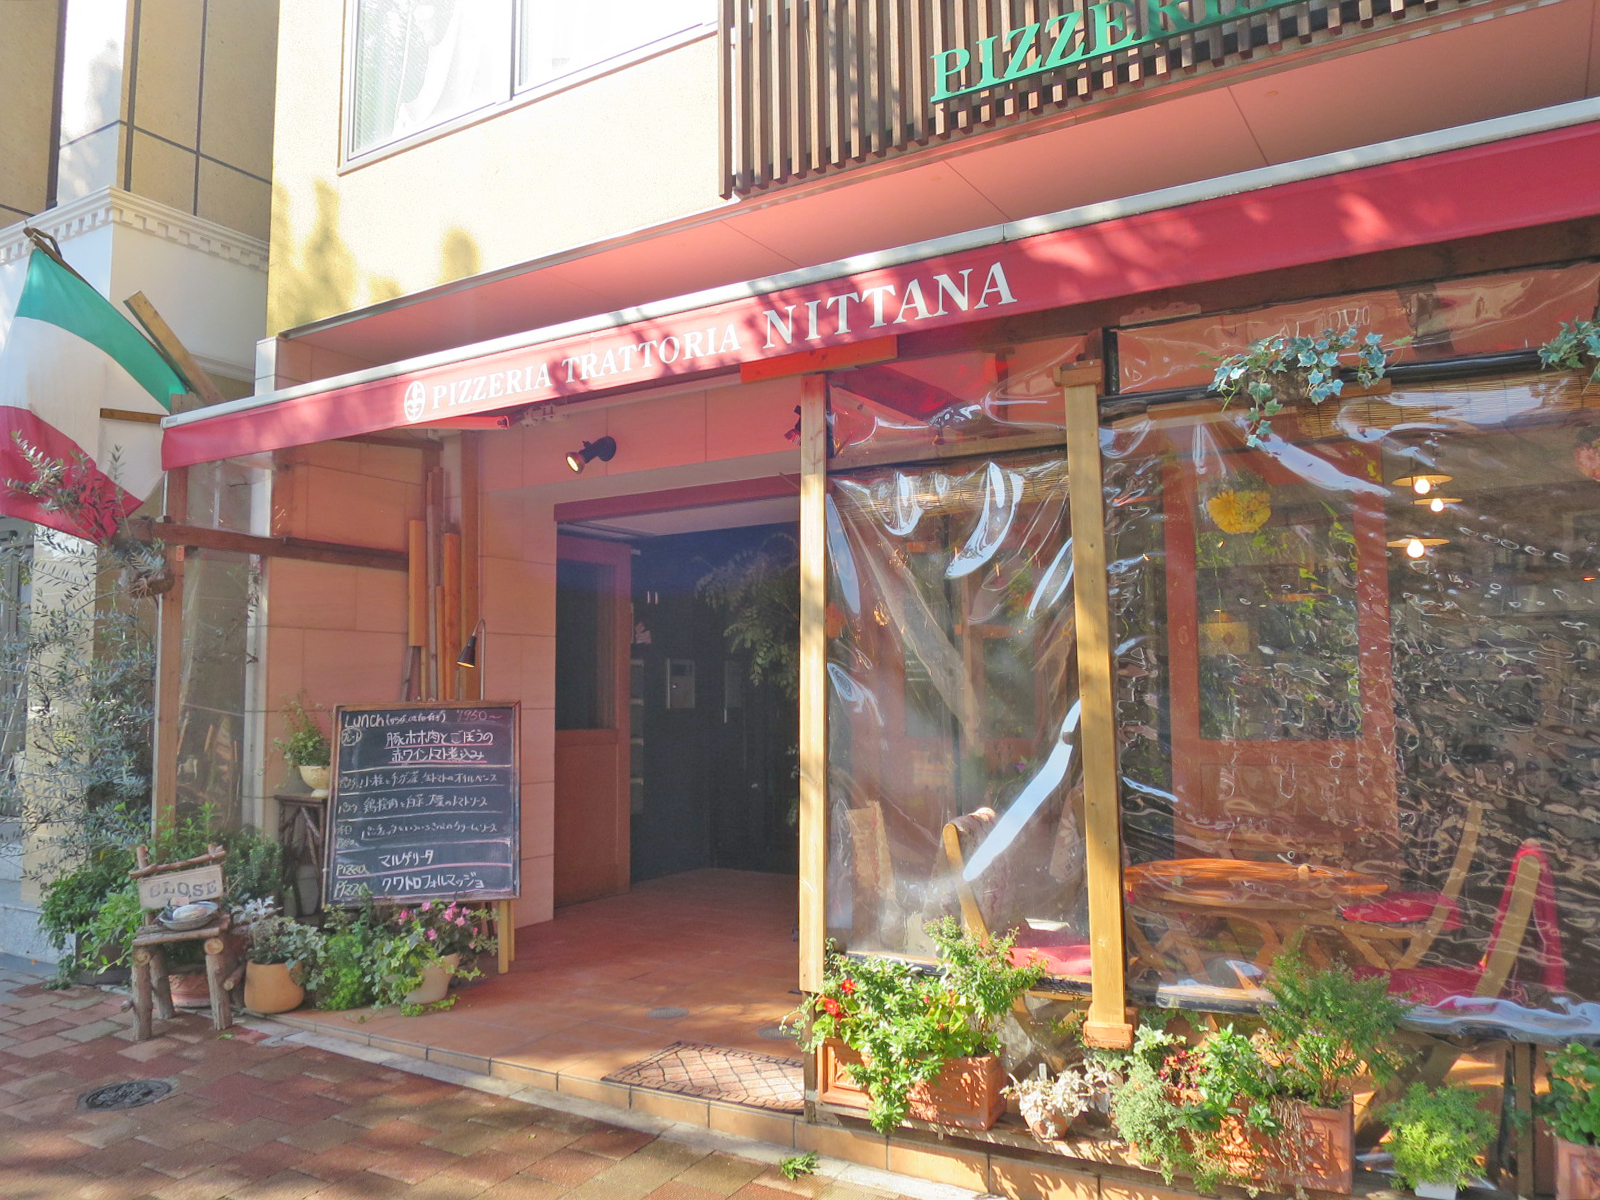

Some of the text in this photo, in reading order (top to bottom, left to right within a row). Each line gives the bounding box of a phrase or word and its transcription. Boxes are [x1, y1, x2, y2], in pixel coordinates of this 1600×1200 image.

[432, 261, 1017, 409] PIZZERIA TRATTORIA NITTANA
[378, 849, 434, 868] マルゲリータ
[149, 880, 218, 898] CLOSE
[381, 871, 485, 893] クワトロフォルマッジョ
